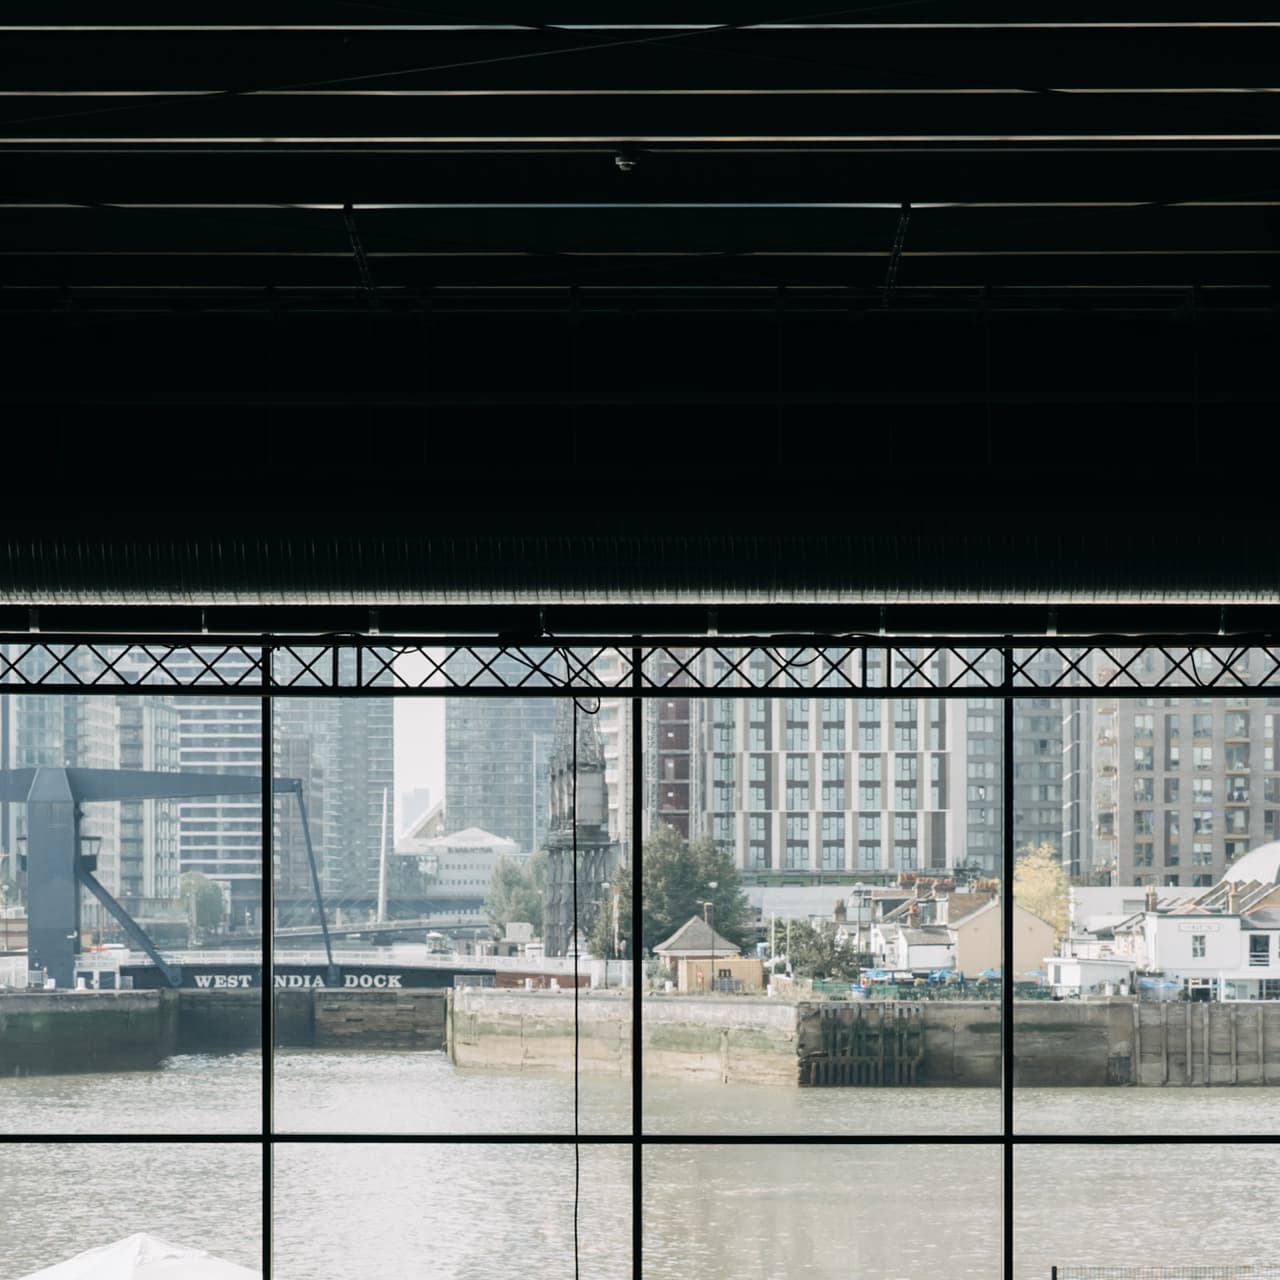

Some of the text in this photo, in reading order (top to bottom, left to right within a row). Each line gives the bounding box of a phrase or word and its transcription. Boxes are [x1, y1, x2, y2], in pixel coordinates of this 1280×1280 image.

[194, 975, 402, 988] WEST NDIA DOCK
